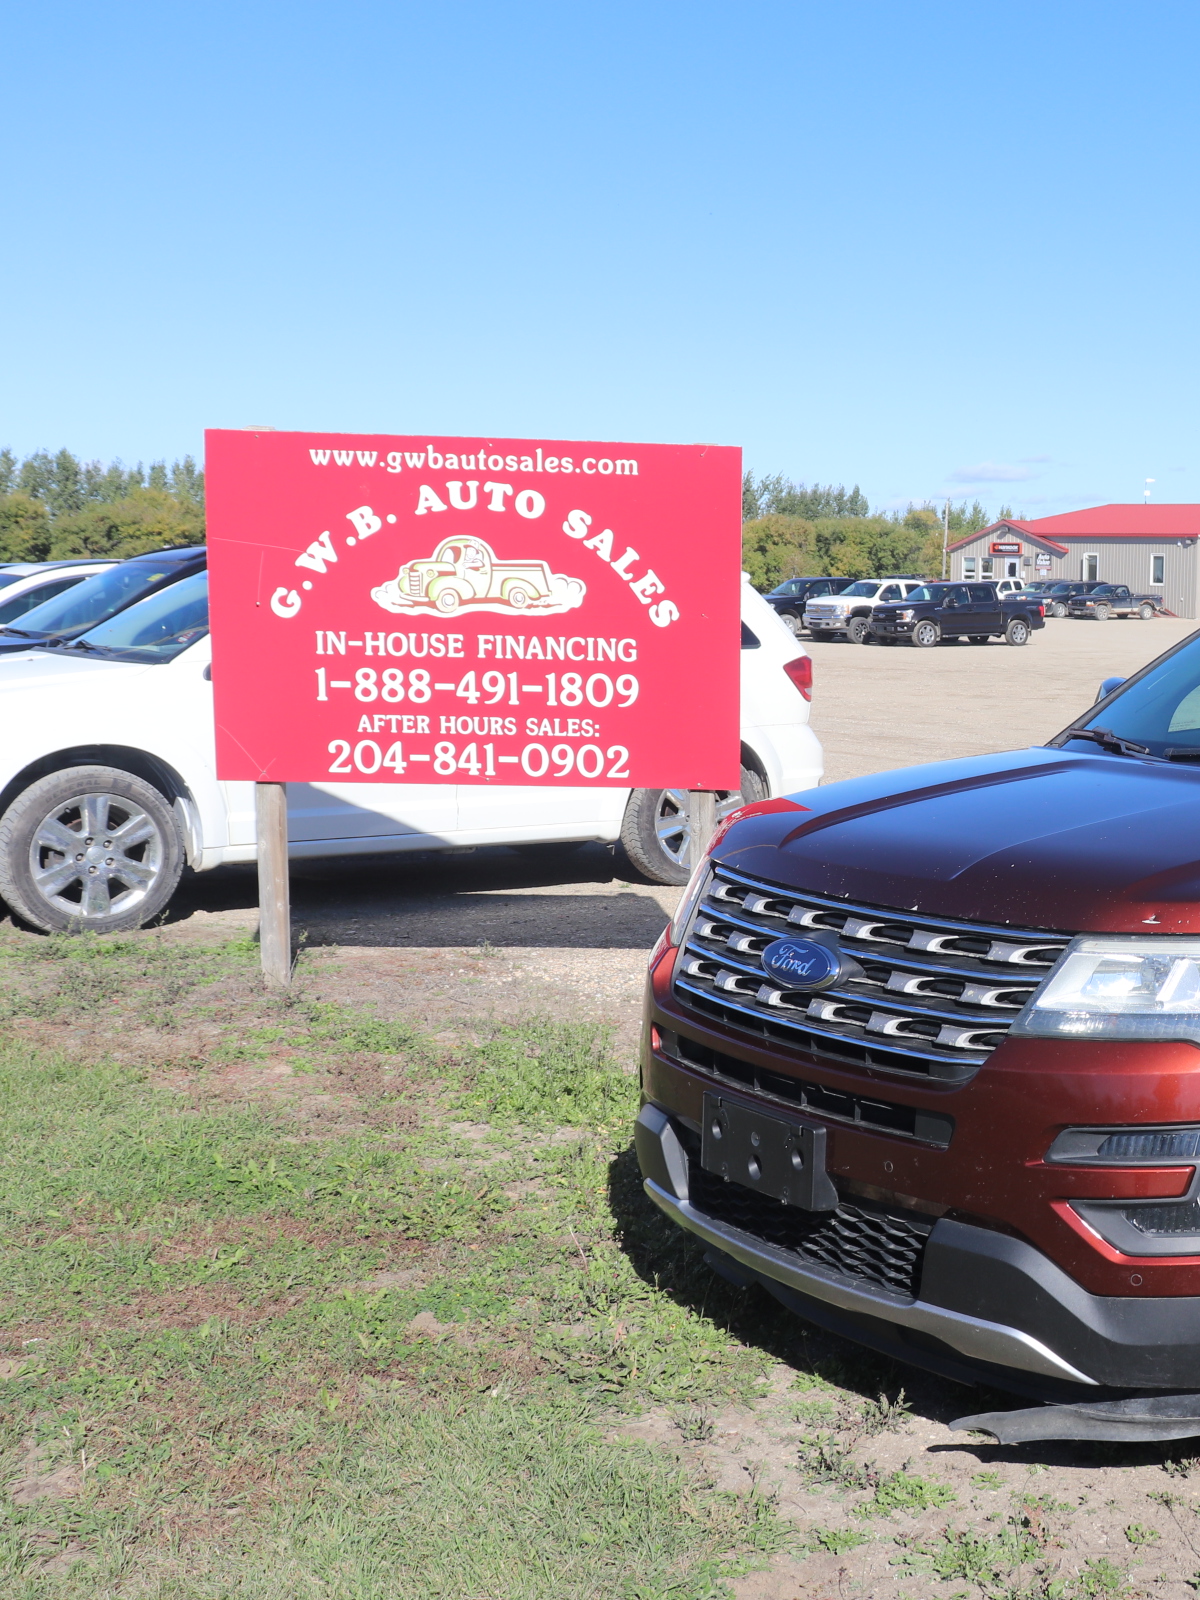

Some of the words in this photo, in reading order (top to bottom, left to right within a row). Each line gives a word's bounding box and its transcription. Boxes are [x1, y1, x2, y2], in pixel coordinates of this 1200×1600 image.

[308, 445, 639, 476] www.gwbautosales.com
[270, 505, 397, 619] G.W.B.
[414, 480, 546, 520] AUTO
[561, 509, 681, 628] SALES
[314, 630, 465, 659] IN-HOUSE
[476, 634, 638, 663] FINANCING
[314, 666, 640, 708] 1-888-491-1809
[356, 714, 431, 734] AFTER
[439, 715, 517, 737] HOURS
[525, 717, 601, 738] SALES:
[327, 739, 631, 779] 204-841-0902
[771, 943, 817, 977] Ford
